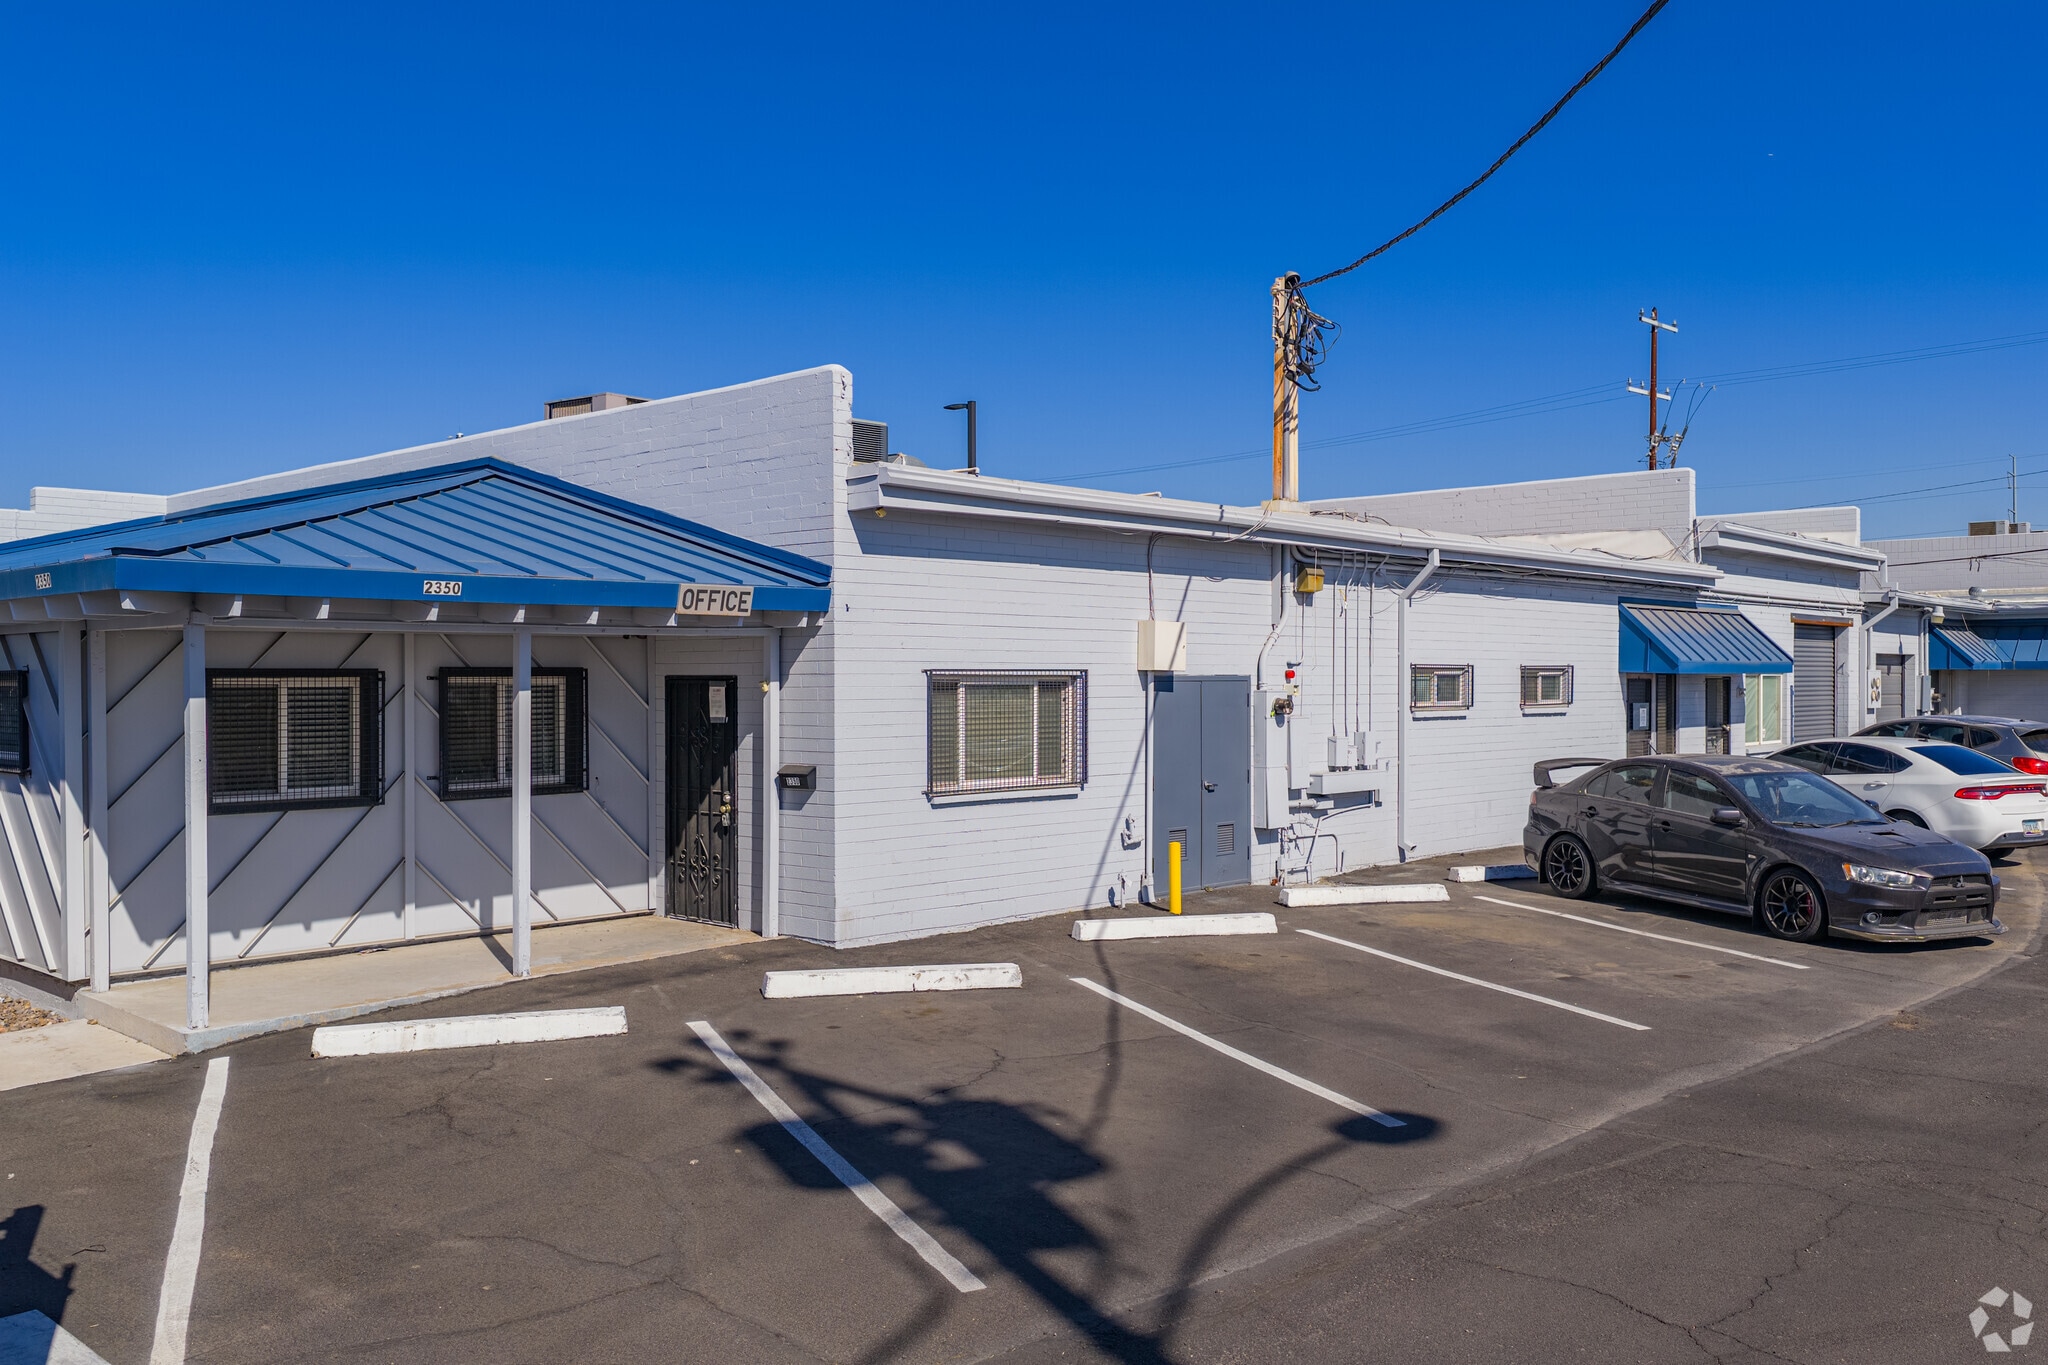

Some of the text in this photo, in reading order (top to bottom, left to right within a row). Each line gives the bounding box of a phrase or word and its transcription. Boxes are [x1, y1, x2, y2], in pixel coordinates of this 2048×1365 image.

[36, 573, 51, 589] 2350
[424, 581, 461, 595] 2350
[682, 588, 751, 613] OFFICE
